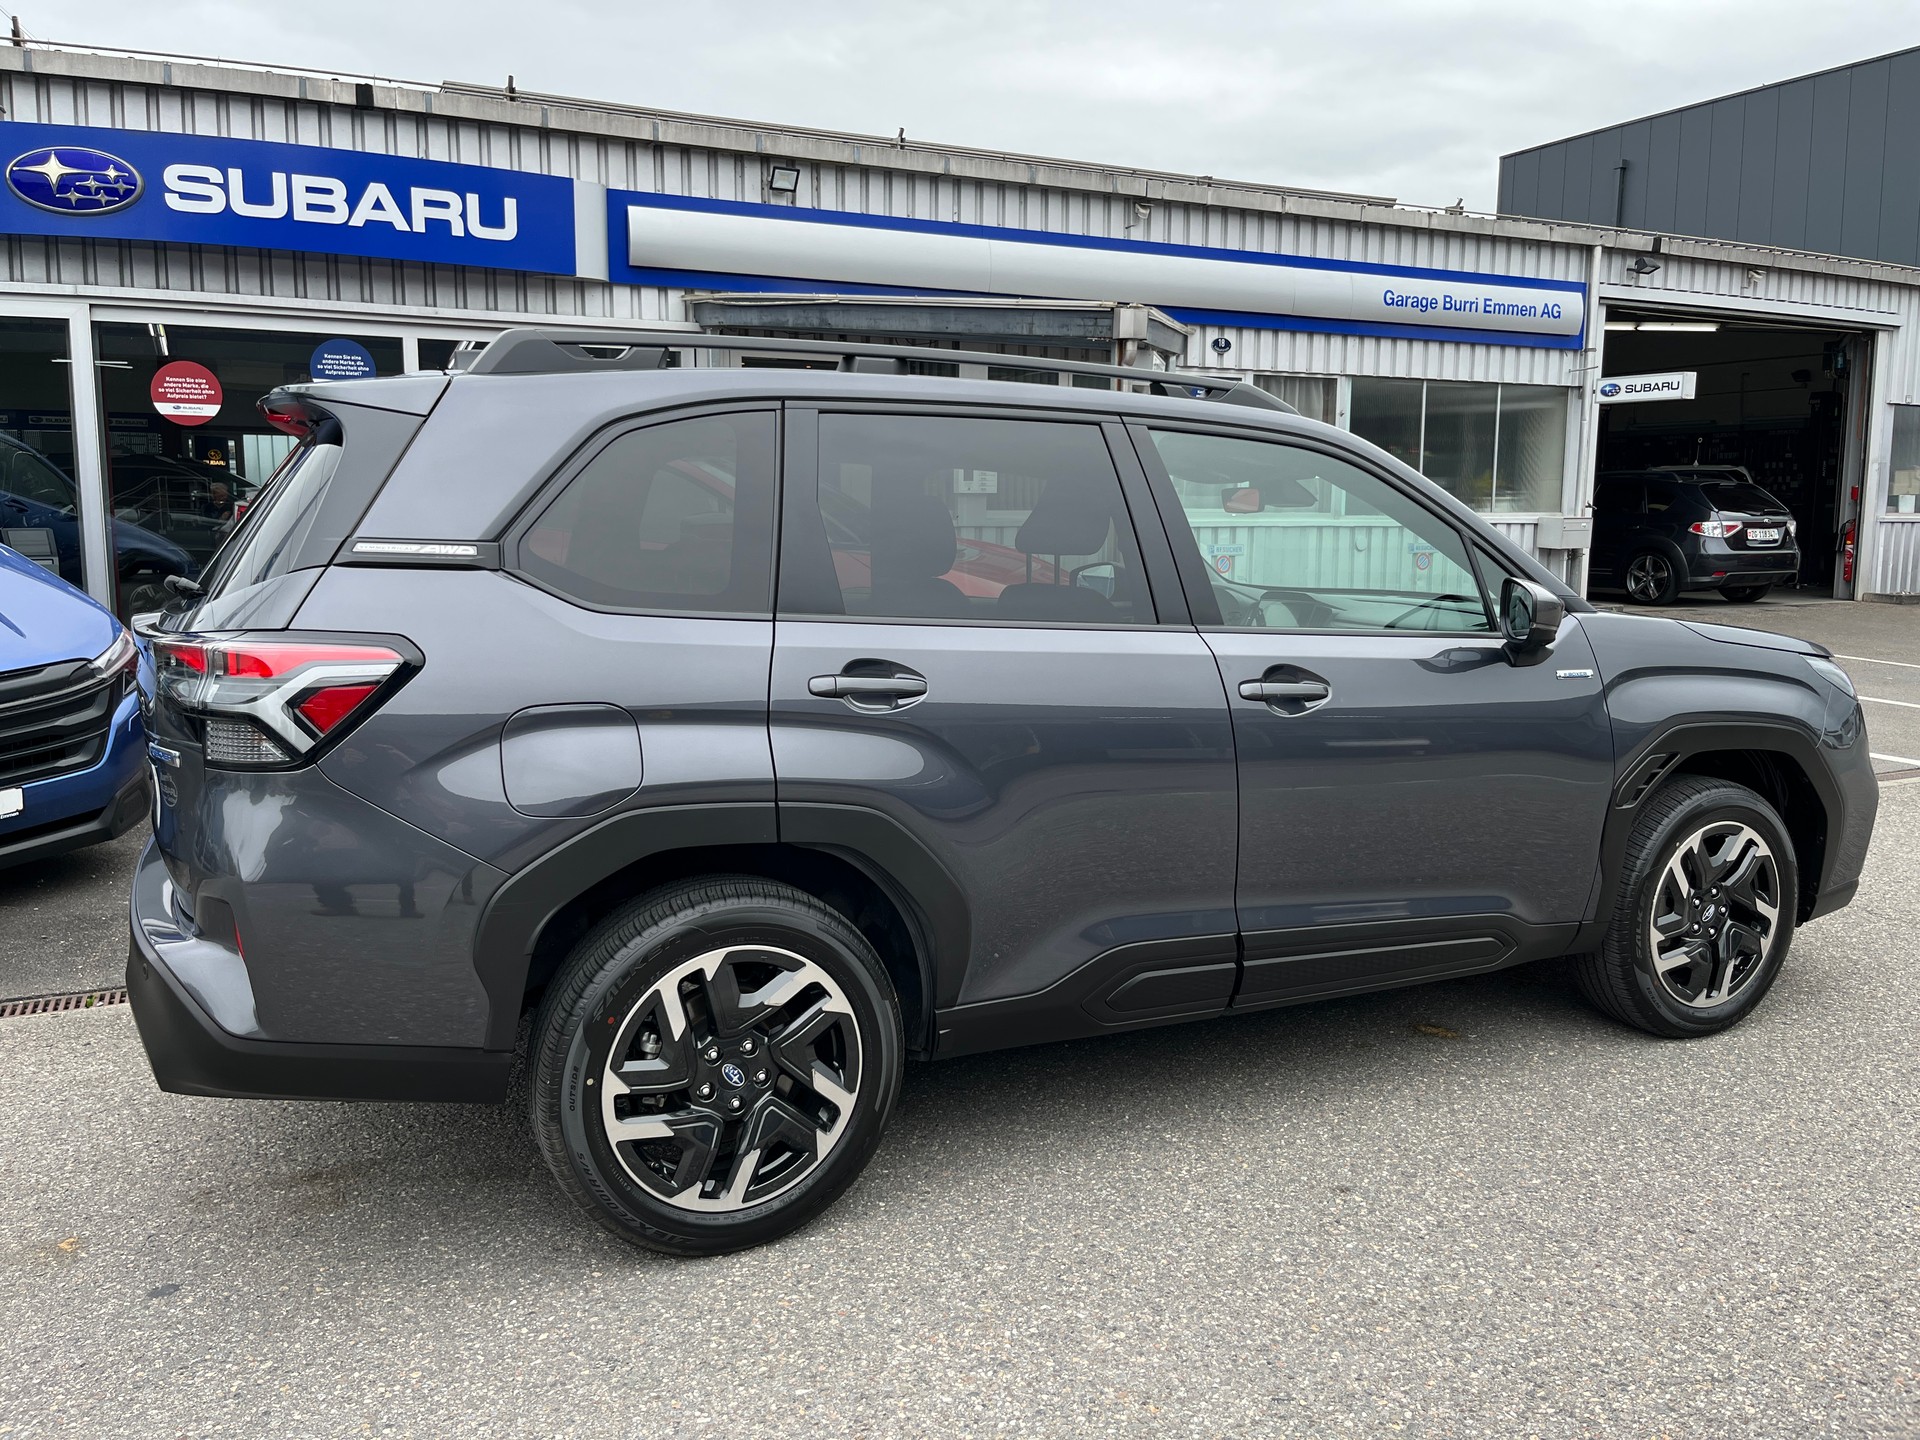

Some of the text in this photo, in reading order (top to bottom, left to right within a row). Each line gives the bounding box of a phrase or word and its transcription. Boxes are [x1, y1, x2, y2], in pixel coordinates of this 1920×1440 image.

[163, 163, 518, 241] SUBARU
[1383, 289, 1562, 319] Garage Burri Emmen AG
[1625, 381, 1680, 393] SUBARU
[418, 544, 476, 556] AWD
[569, 1065, 580, 1112] OUTSIDE
